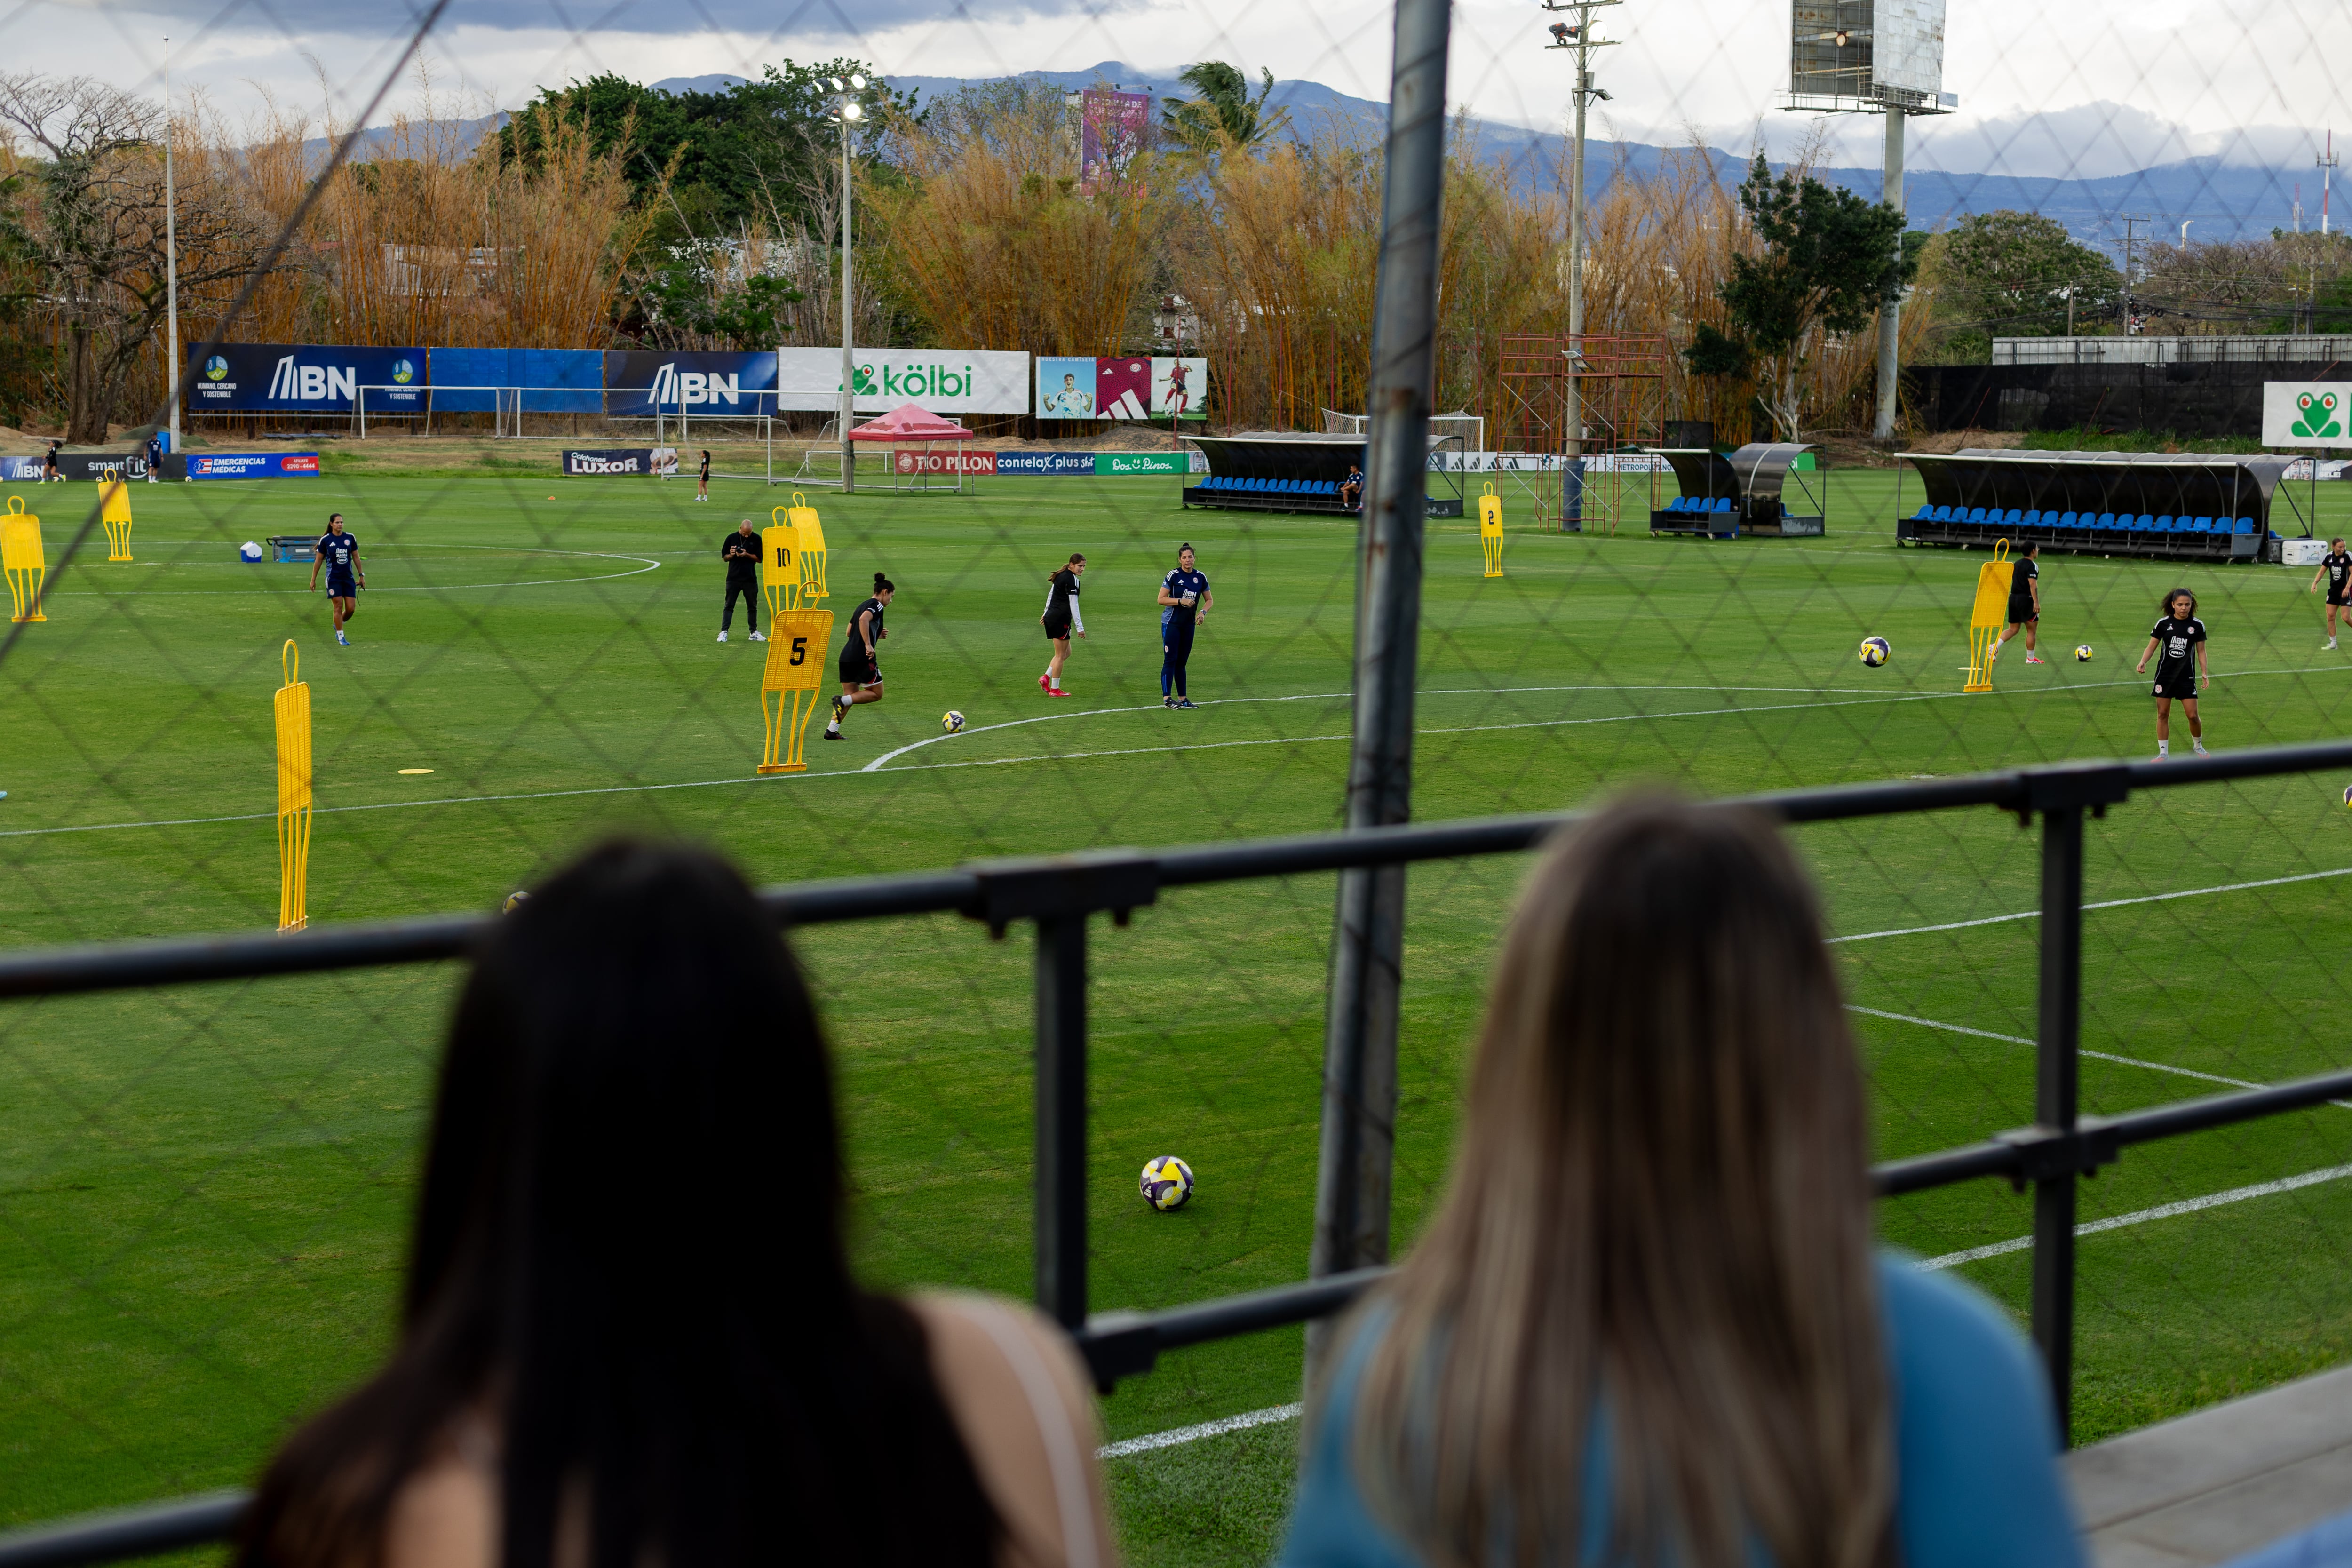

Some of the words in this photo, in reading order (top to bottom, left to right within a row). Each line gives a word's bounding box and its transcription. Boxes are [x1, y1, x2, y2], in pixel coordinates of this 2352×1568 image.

[884, 365, 971, 397] kölbi
[88, 461, 124, 471] smart
[126, 456, 148, 473] fit
[213, 458, 266, 466] EMERGENCIAS
[571, 452, 606, 463] Colchones
[1056, 456, 1079, 470] plus
[212, 465, 246, 473] MÉDICAS
[1488, 510, 1494, 525] 2
[790, 637, 807, 666] 5
